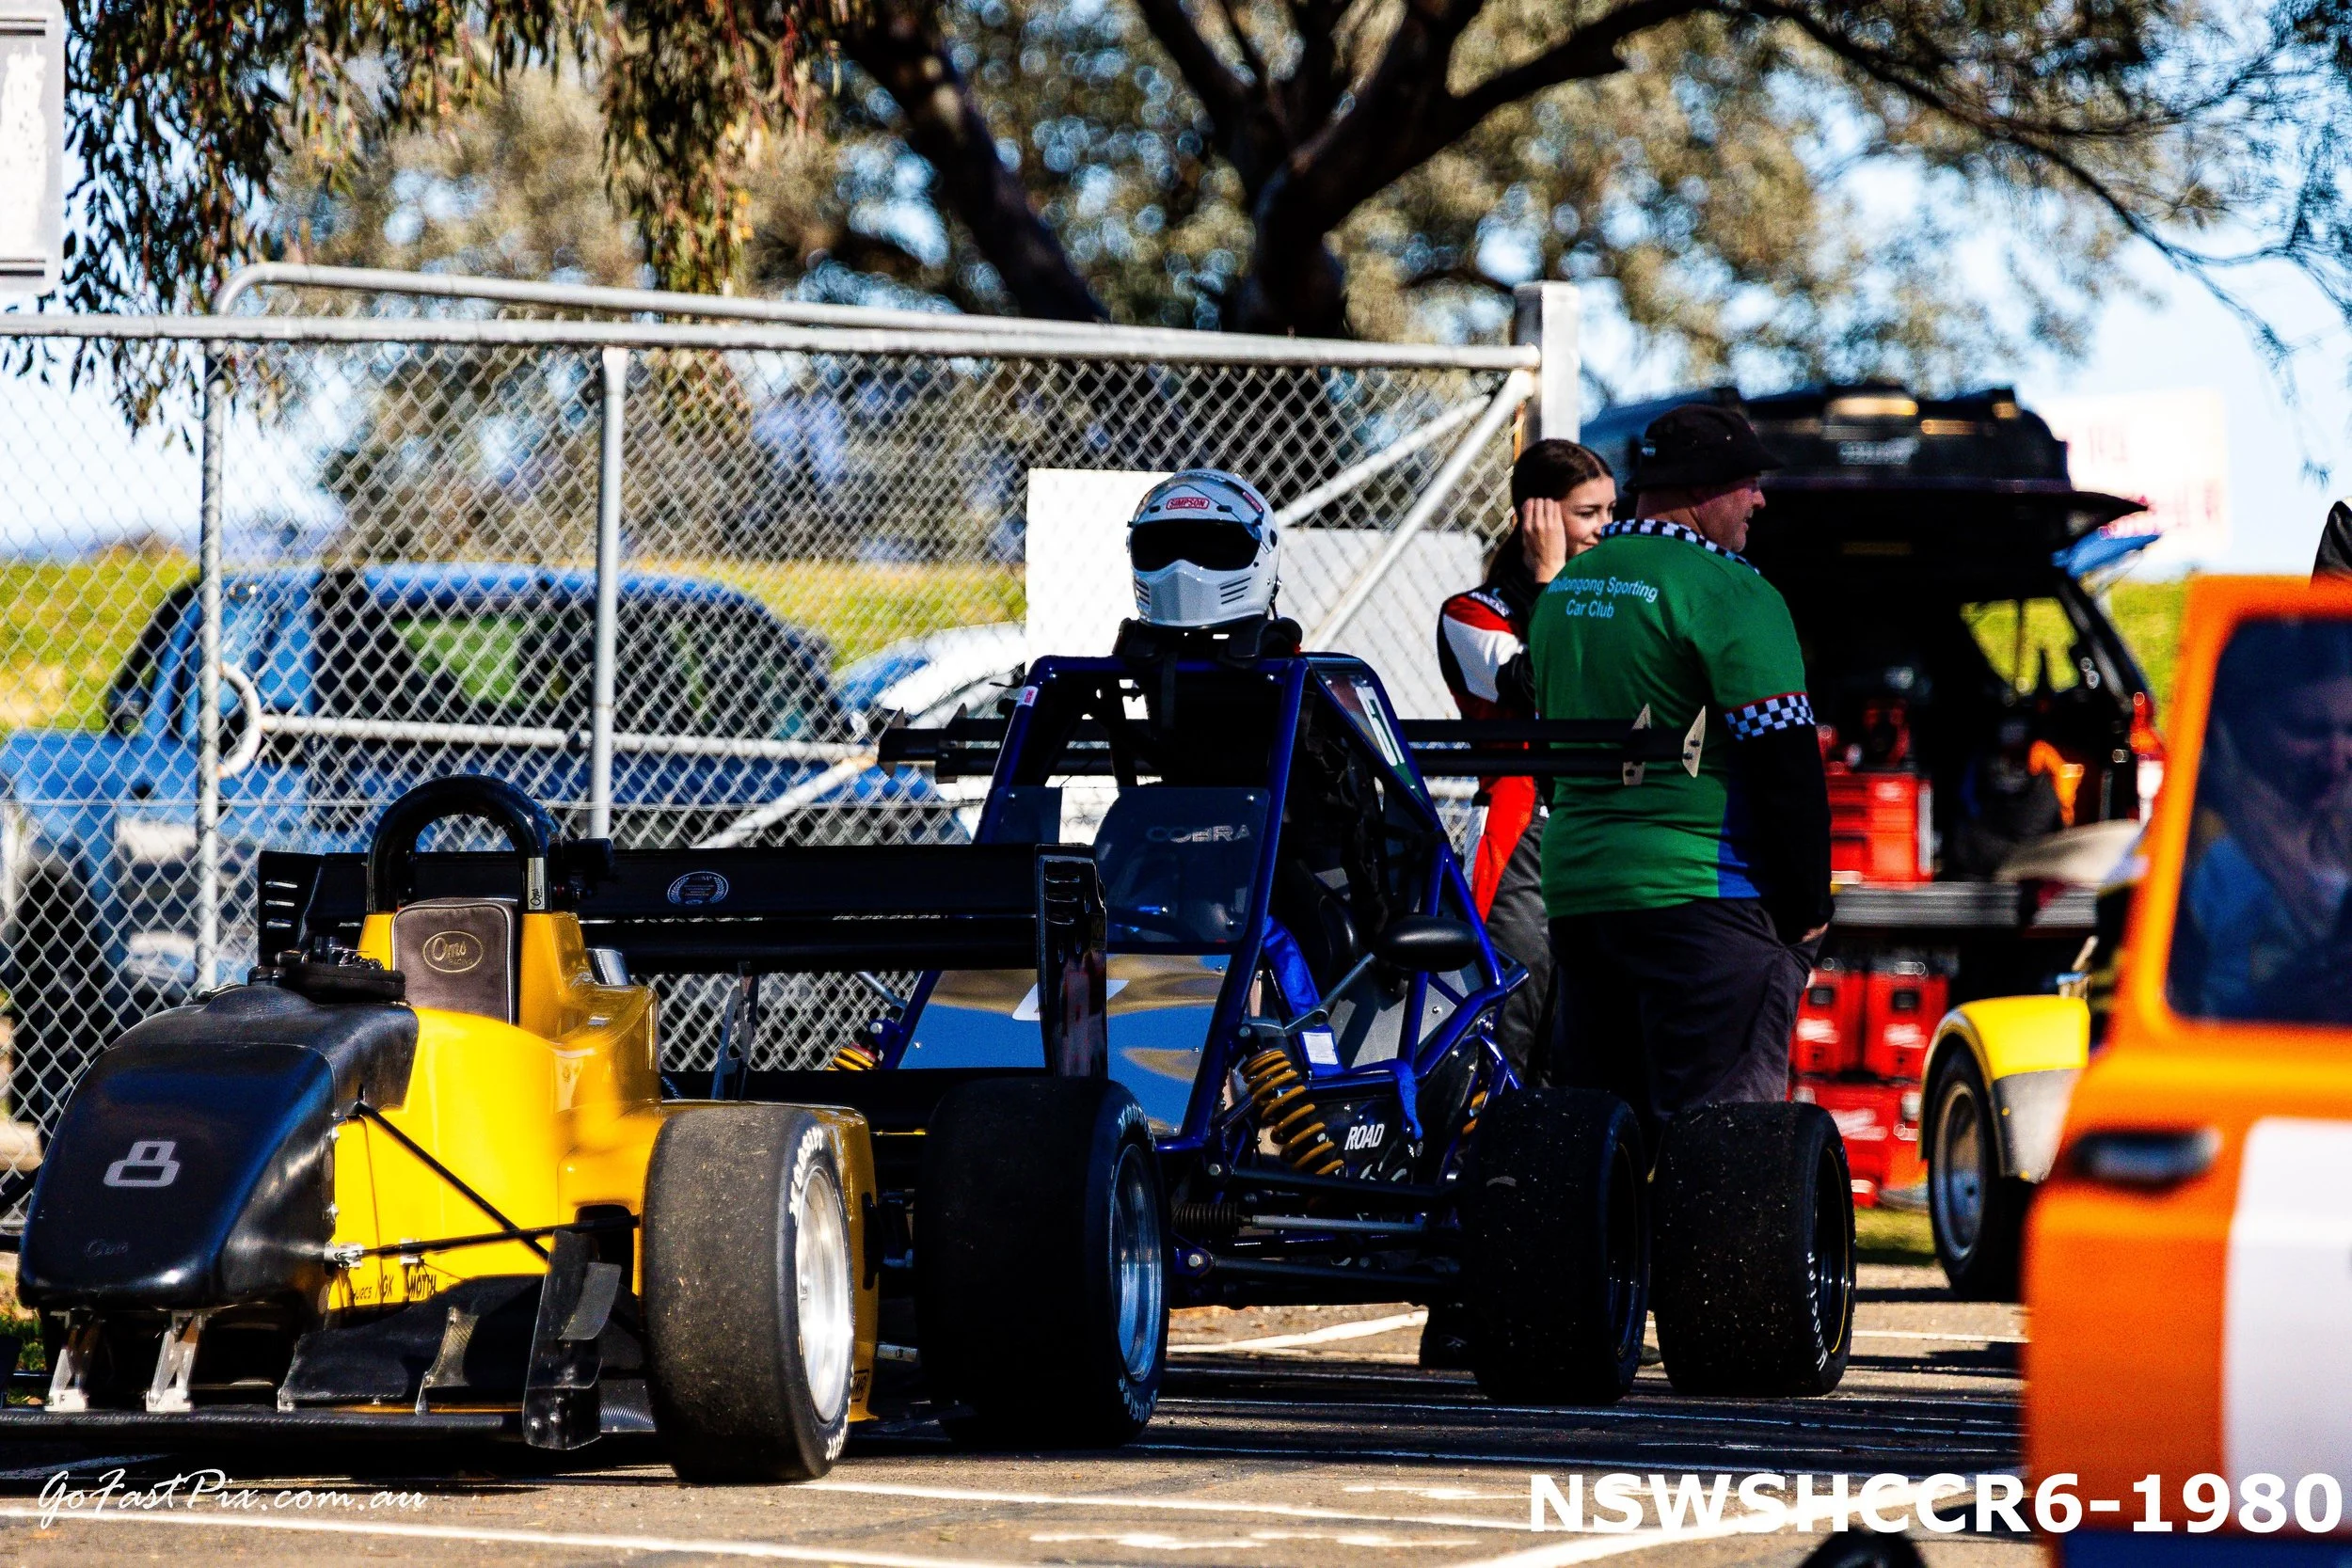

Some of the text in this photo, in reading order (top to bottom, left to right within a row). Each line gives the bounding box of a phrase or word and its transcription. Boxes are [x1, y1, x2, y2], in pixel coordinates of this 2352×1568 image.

[1168, 499, 1208, 509] SIMPSON
[1607, 576, 1659, 603] Sporting
[1565, 598, 1614, 619] Car Club
[1146, 824, 1250, 844] COBRA
[1343, 1123, 1386, 1150] ROAD
[103, 1140, 181, 1188] 8
